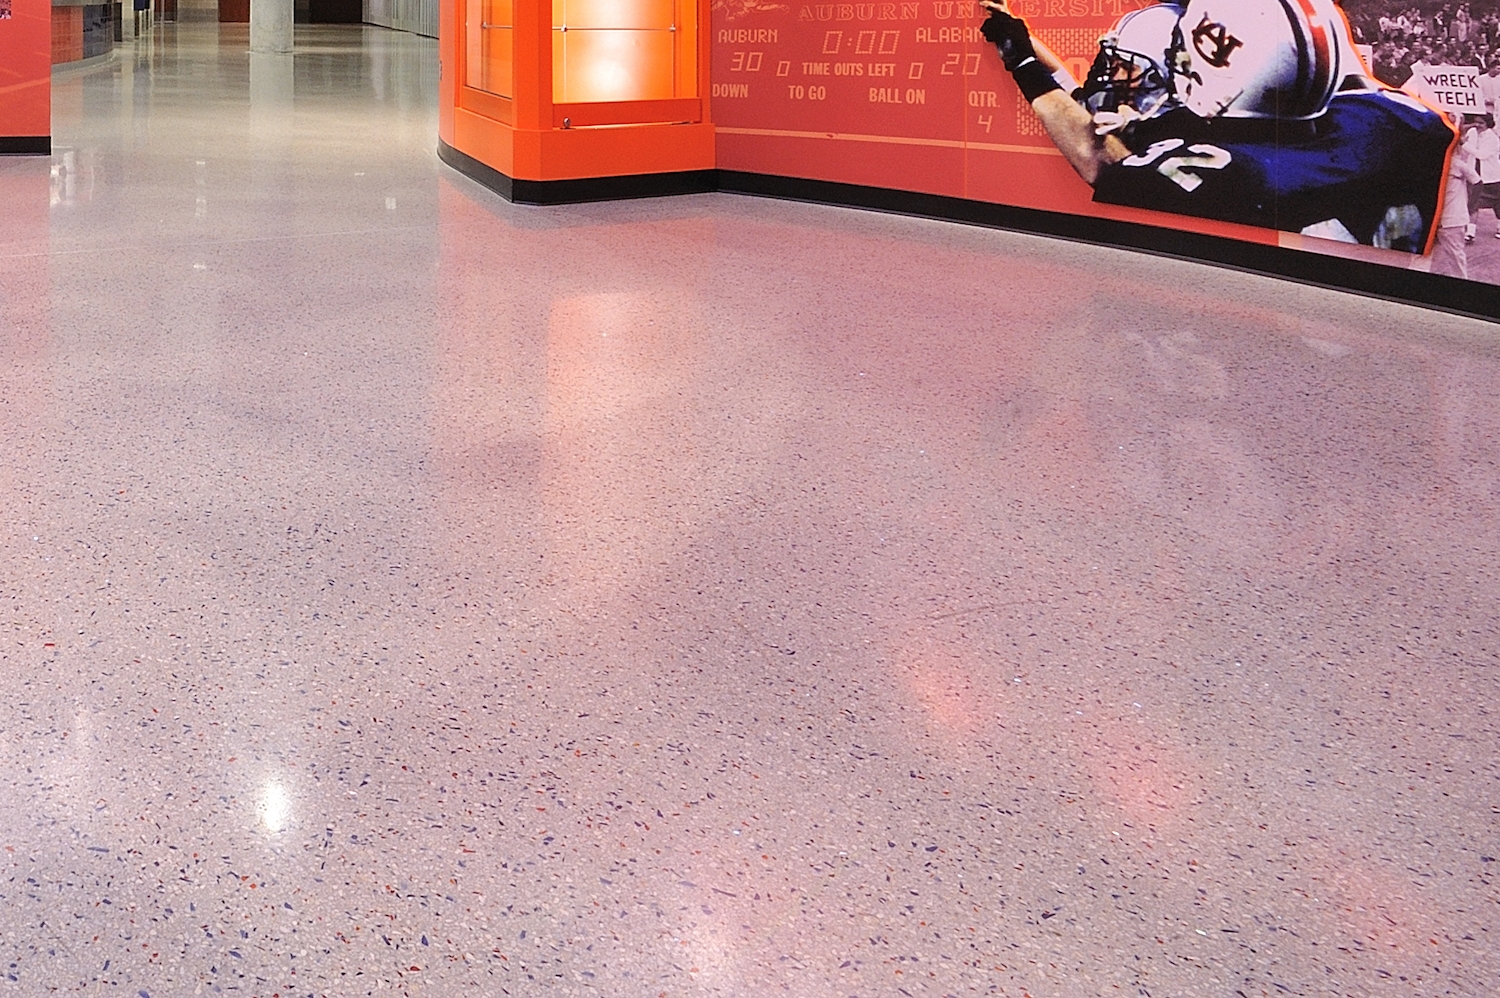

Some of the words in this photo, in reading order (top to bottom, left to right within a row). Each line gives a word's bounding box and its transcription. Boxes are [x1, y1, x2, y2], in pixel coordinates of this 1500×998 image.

[798, 3, 919, 21] AUBURN
[718, 29, 777, 43] AUBURN
[730, 52, 763, 71] 30
[941, 54, 981, 75] 20
[802, 62, 830, 76] TIME
[834, 63, 864, 77] OUTS
[868, 63, 895, 77] LEFT
[1423, 74, 1479, 88] WRECK
[712, 84, 748, 98] DOWN
[788, 85, 804, 99] TO
[808, 86, 826, 100] GO
[869, 88, 902, 104] BALL
[906, 89, 925, 104] ON
[1435, 92, 1476, 106] TECH
[977, 115, 993, 133] 4
